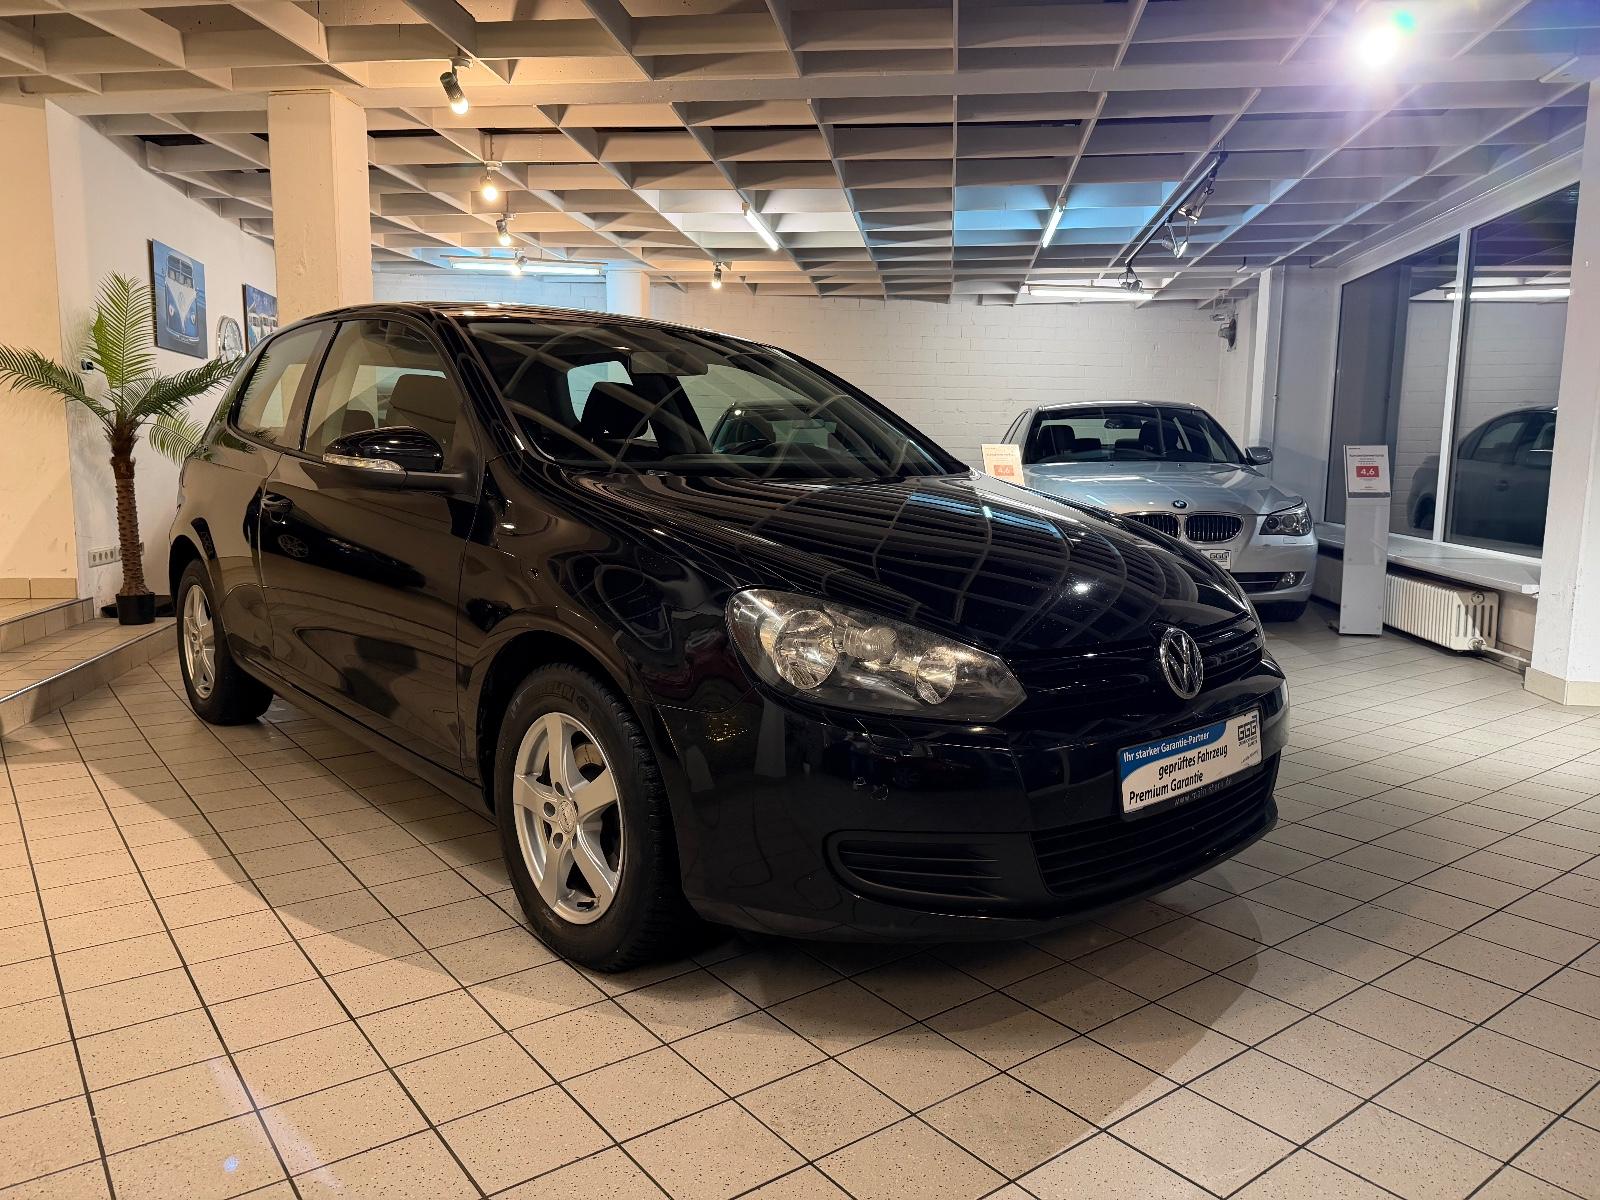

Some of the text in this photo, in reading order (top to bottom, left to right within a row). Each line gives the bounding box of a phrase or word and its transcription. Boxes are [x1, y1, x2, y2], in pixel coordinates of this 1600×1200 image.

[1360, 468, 1375, 476] 4,6
[1123, 731, 1210, 763] Ihr starker Garantie-Partner
[1158, 756, 1196, 781] geprüftes
[1197, 744, 1228, 765] Fahrzeug
[1129, 770, 1204, 805] Premium Garantie
